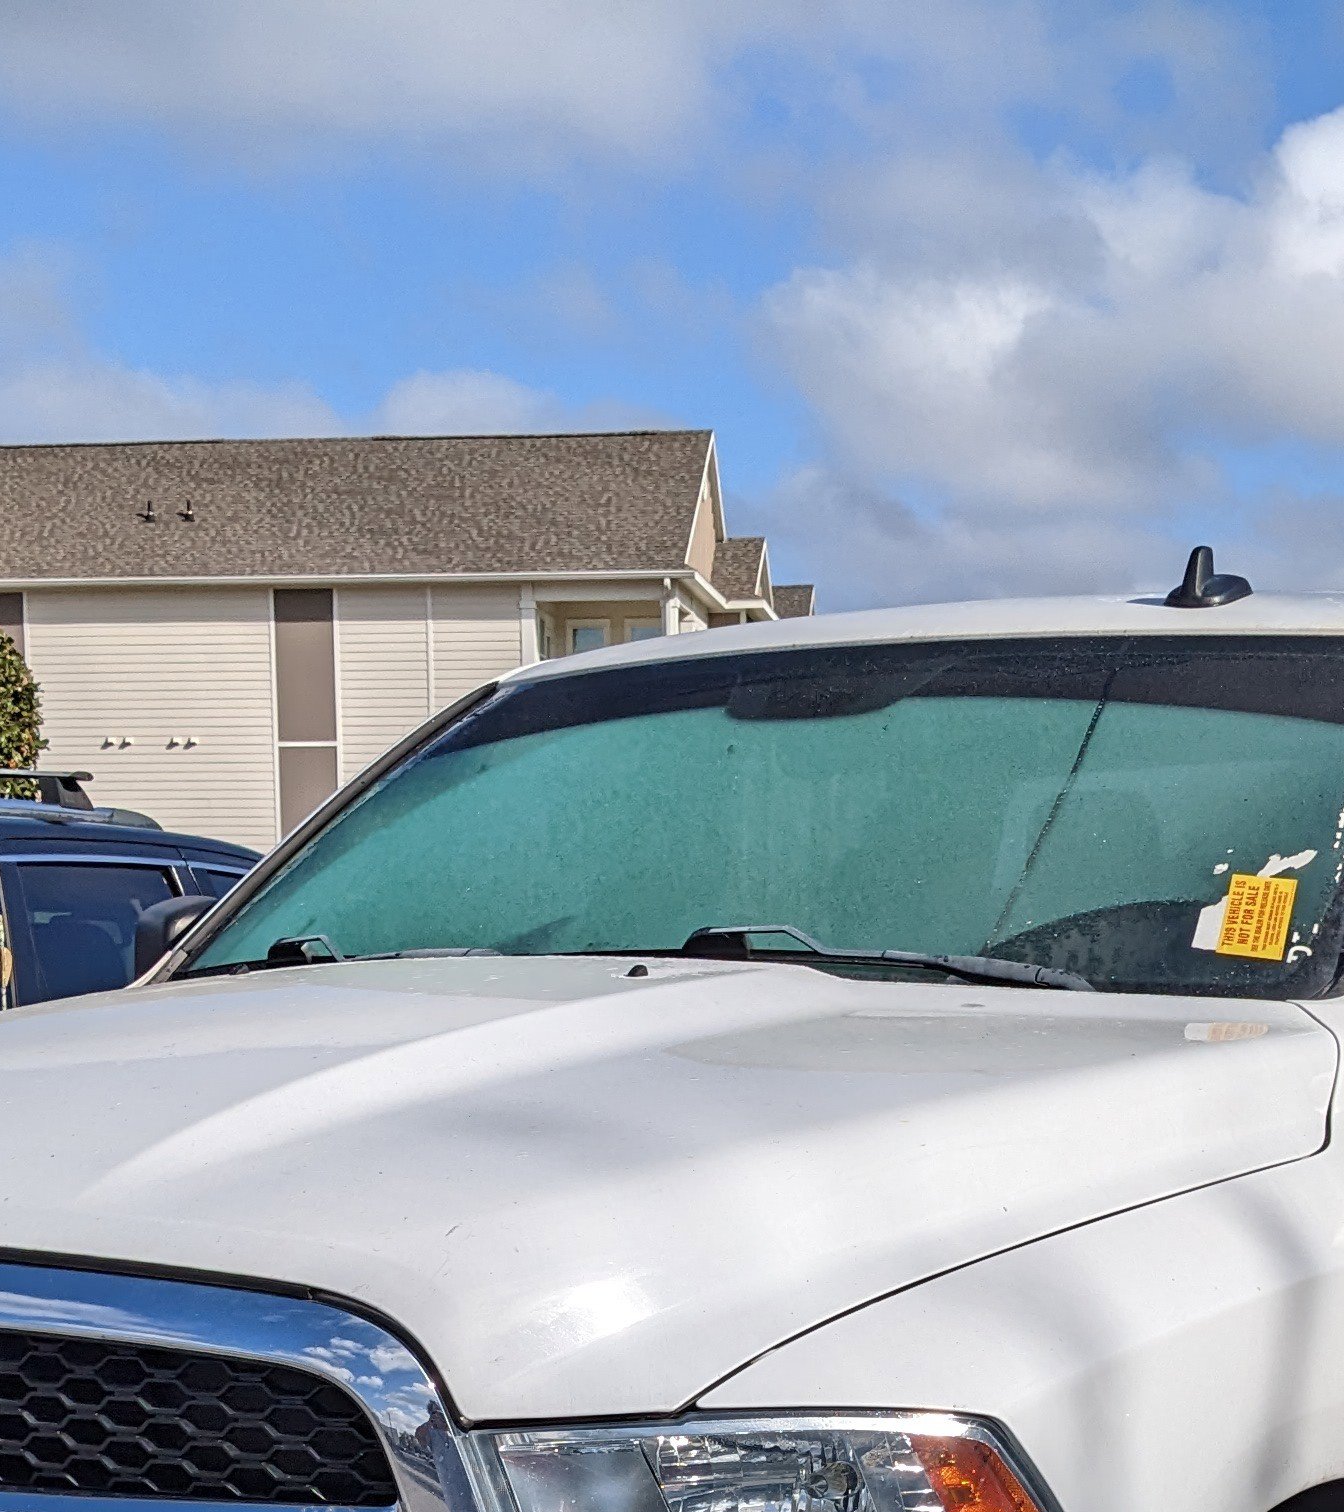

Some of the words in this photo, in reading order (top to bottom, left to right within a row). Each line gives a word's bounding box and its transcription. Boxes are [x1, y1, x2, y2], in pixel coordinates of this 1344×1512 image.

[1235, 880, 1247, 888] IS
[1245, 885, 1260, 907] SALE
[1226, 891, 1244, 925] VEHICLE
[1241, 908, 1254, 925] FOR
[1221, 926, 1236, 947] THIS
[1237, 927, 1251, 945] NOT
